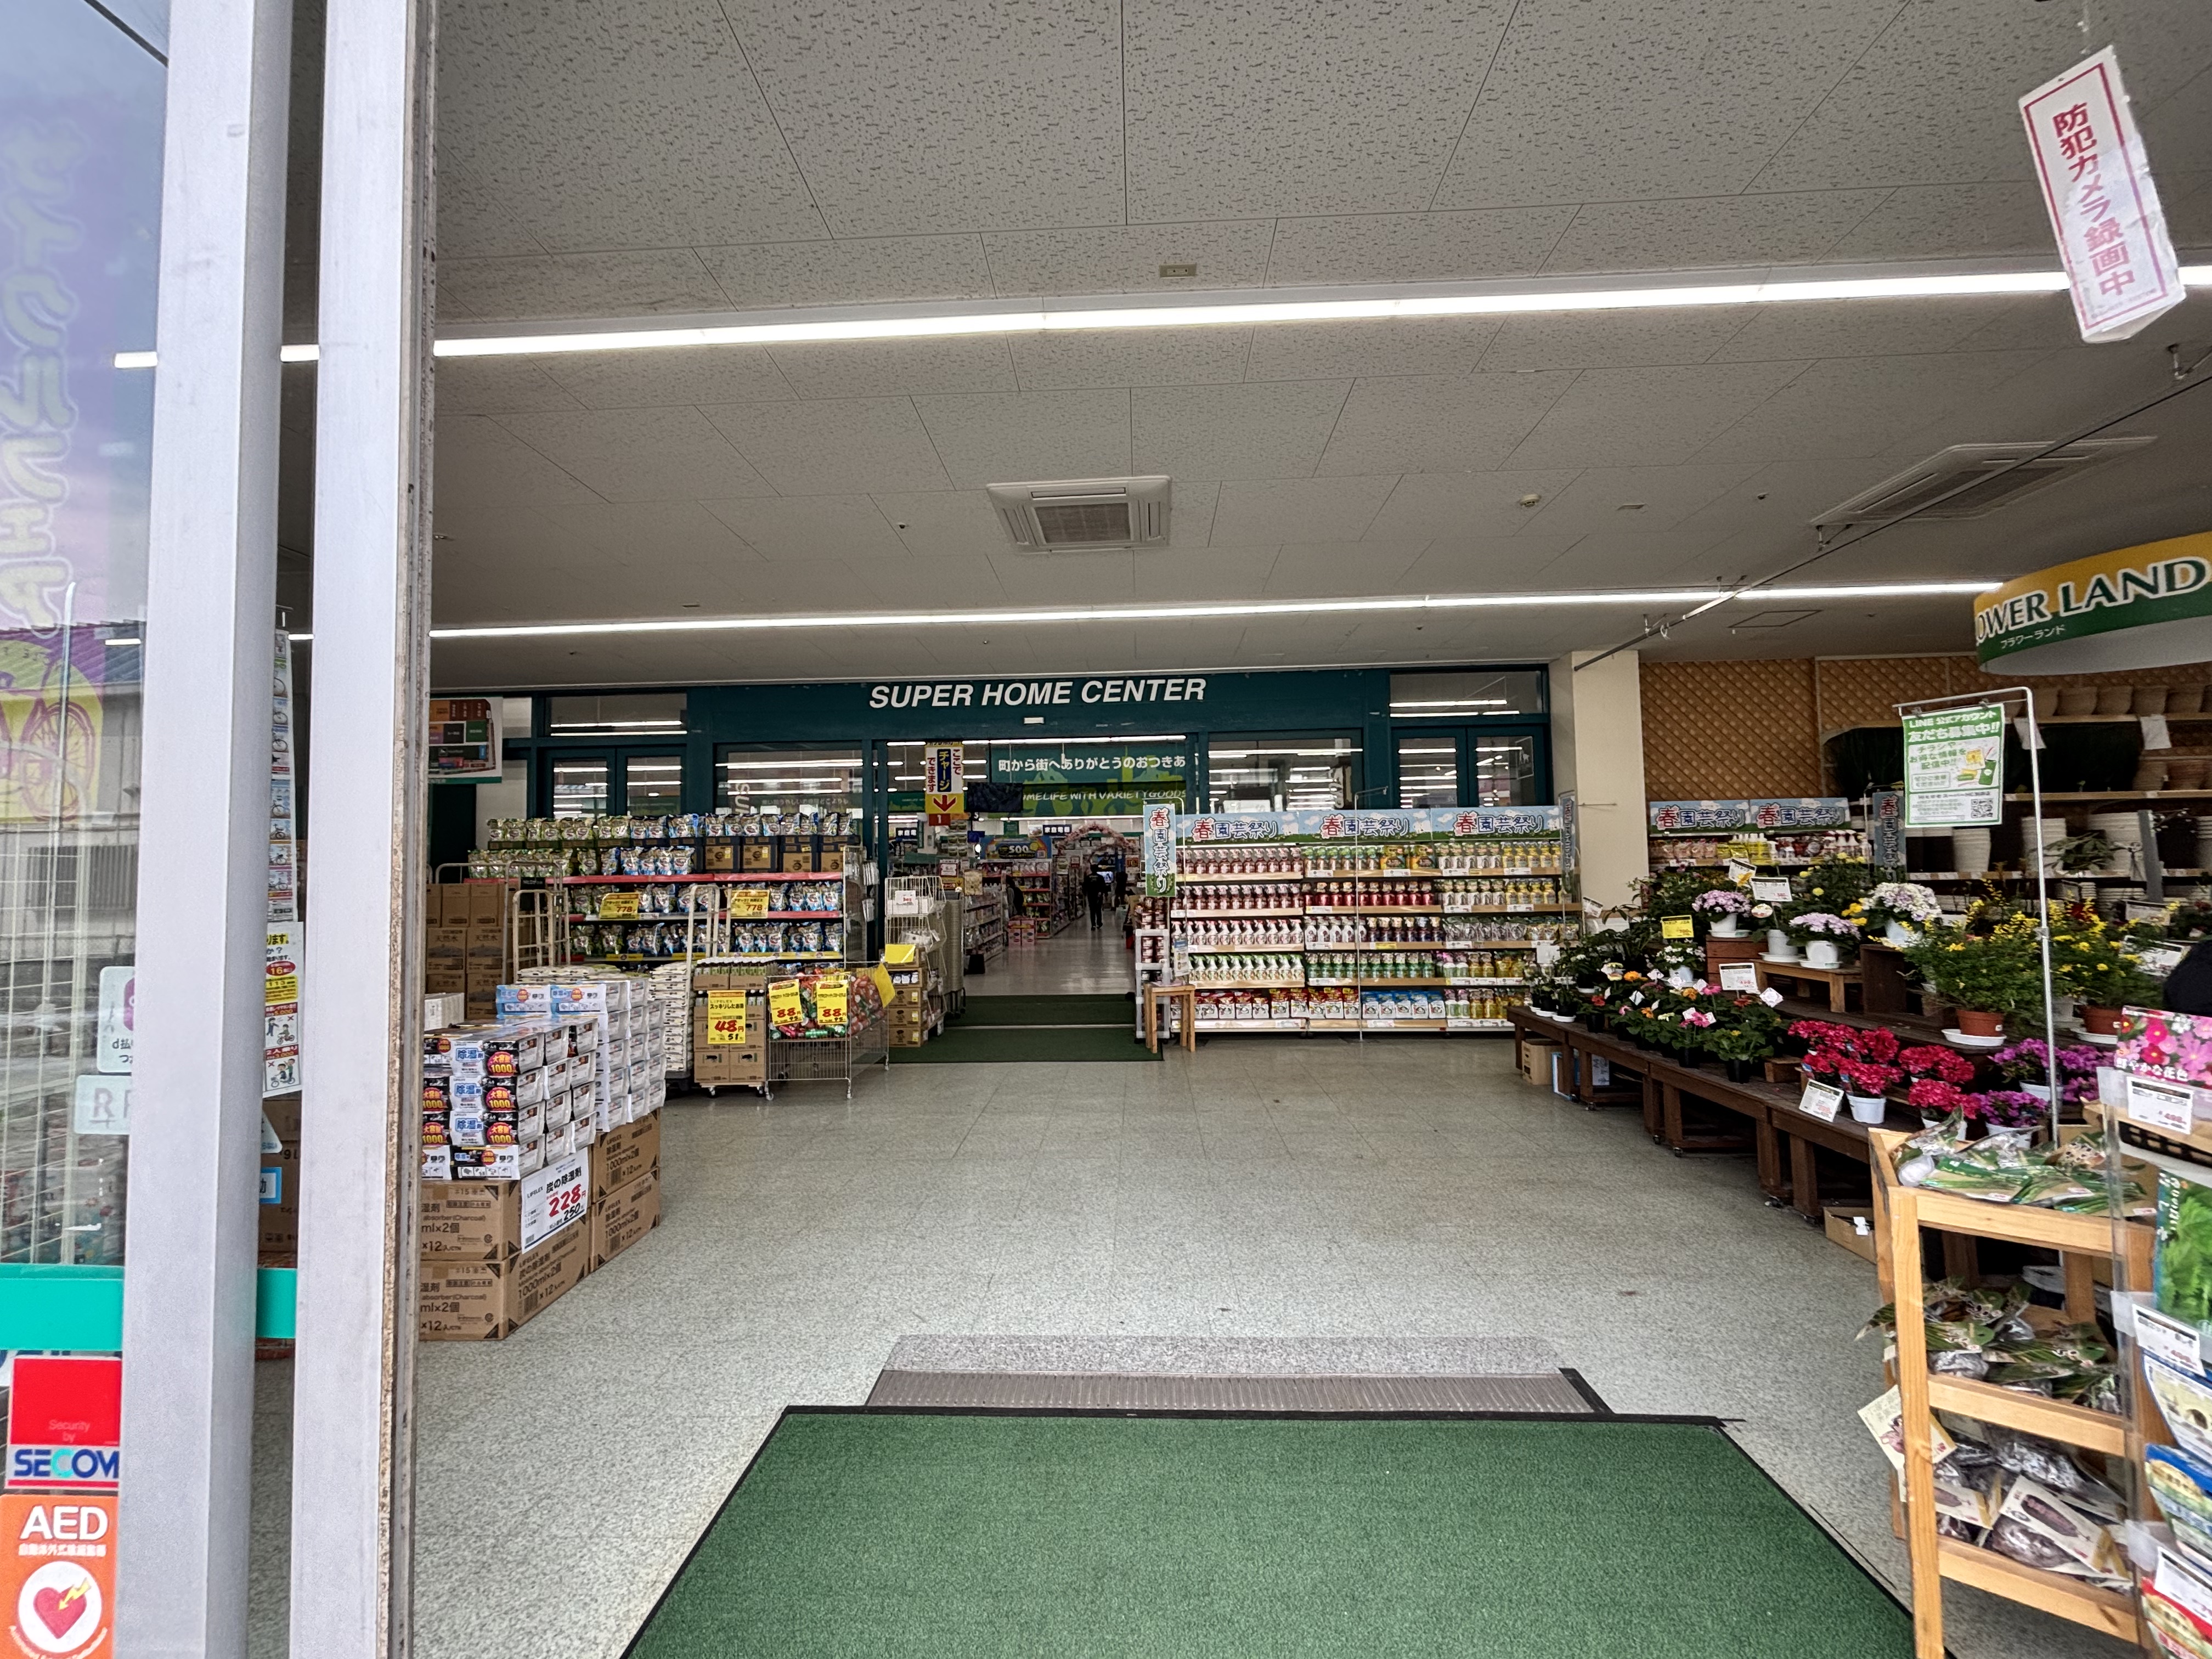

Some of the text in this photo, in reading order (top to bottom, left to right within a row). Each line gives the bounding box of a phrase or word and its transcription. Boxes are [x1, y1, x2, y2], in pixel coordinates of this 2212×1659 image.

[2052, 102, 2136, 297] 防犯カメラ録画中
[2059, 557, 2209, 616] LAND
[2000, 624, 2066, 649] フラワーランド
[869, 679, 1207, 709] SUPER HOME CENTER
[1909, 718, 1934, 728] LINE
[939, 751, 950, 791] チャージ
[952, 749, 961, 775] ここで
[927, 757, 936, 792] できます
[1070, 791, 1097, 800] WITH
[1321, 815, 1410, 837] 春園芸祭り
[1455, 812, 1544, 834] 春園芸祭り
[1658, 807, 1746, 827] 春園芸祭り
[1759, 806, 1846, 827] 春園芸祭り
[1193, 817, 1278, 840] 春園芸祭り
[1149, 809, 1170, 894] 春園芸祭り
[491, 1064, 512, 1073] 1000
[489, 1099, 511, 1108] 1000
[490, 1135, 511, 1143] 1000
[546, 1166, 582, 1194] 炭の除湿剤
[527, 1186, 544, 1199] LIFELEX
[563, 1202, 582, 1221] 250
[48, 1419, 91, 1433] Security
[62, 1431, 76, 1443] by
[14, 1448, 120, 1479] SECOM
[19, 1505, 109, 1540] AED
